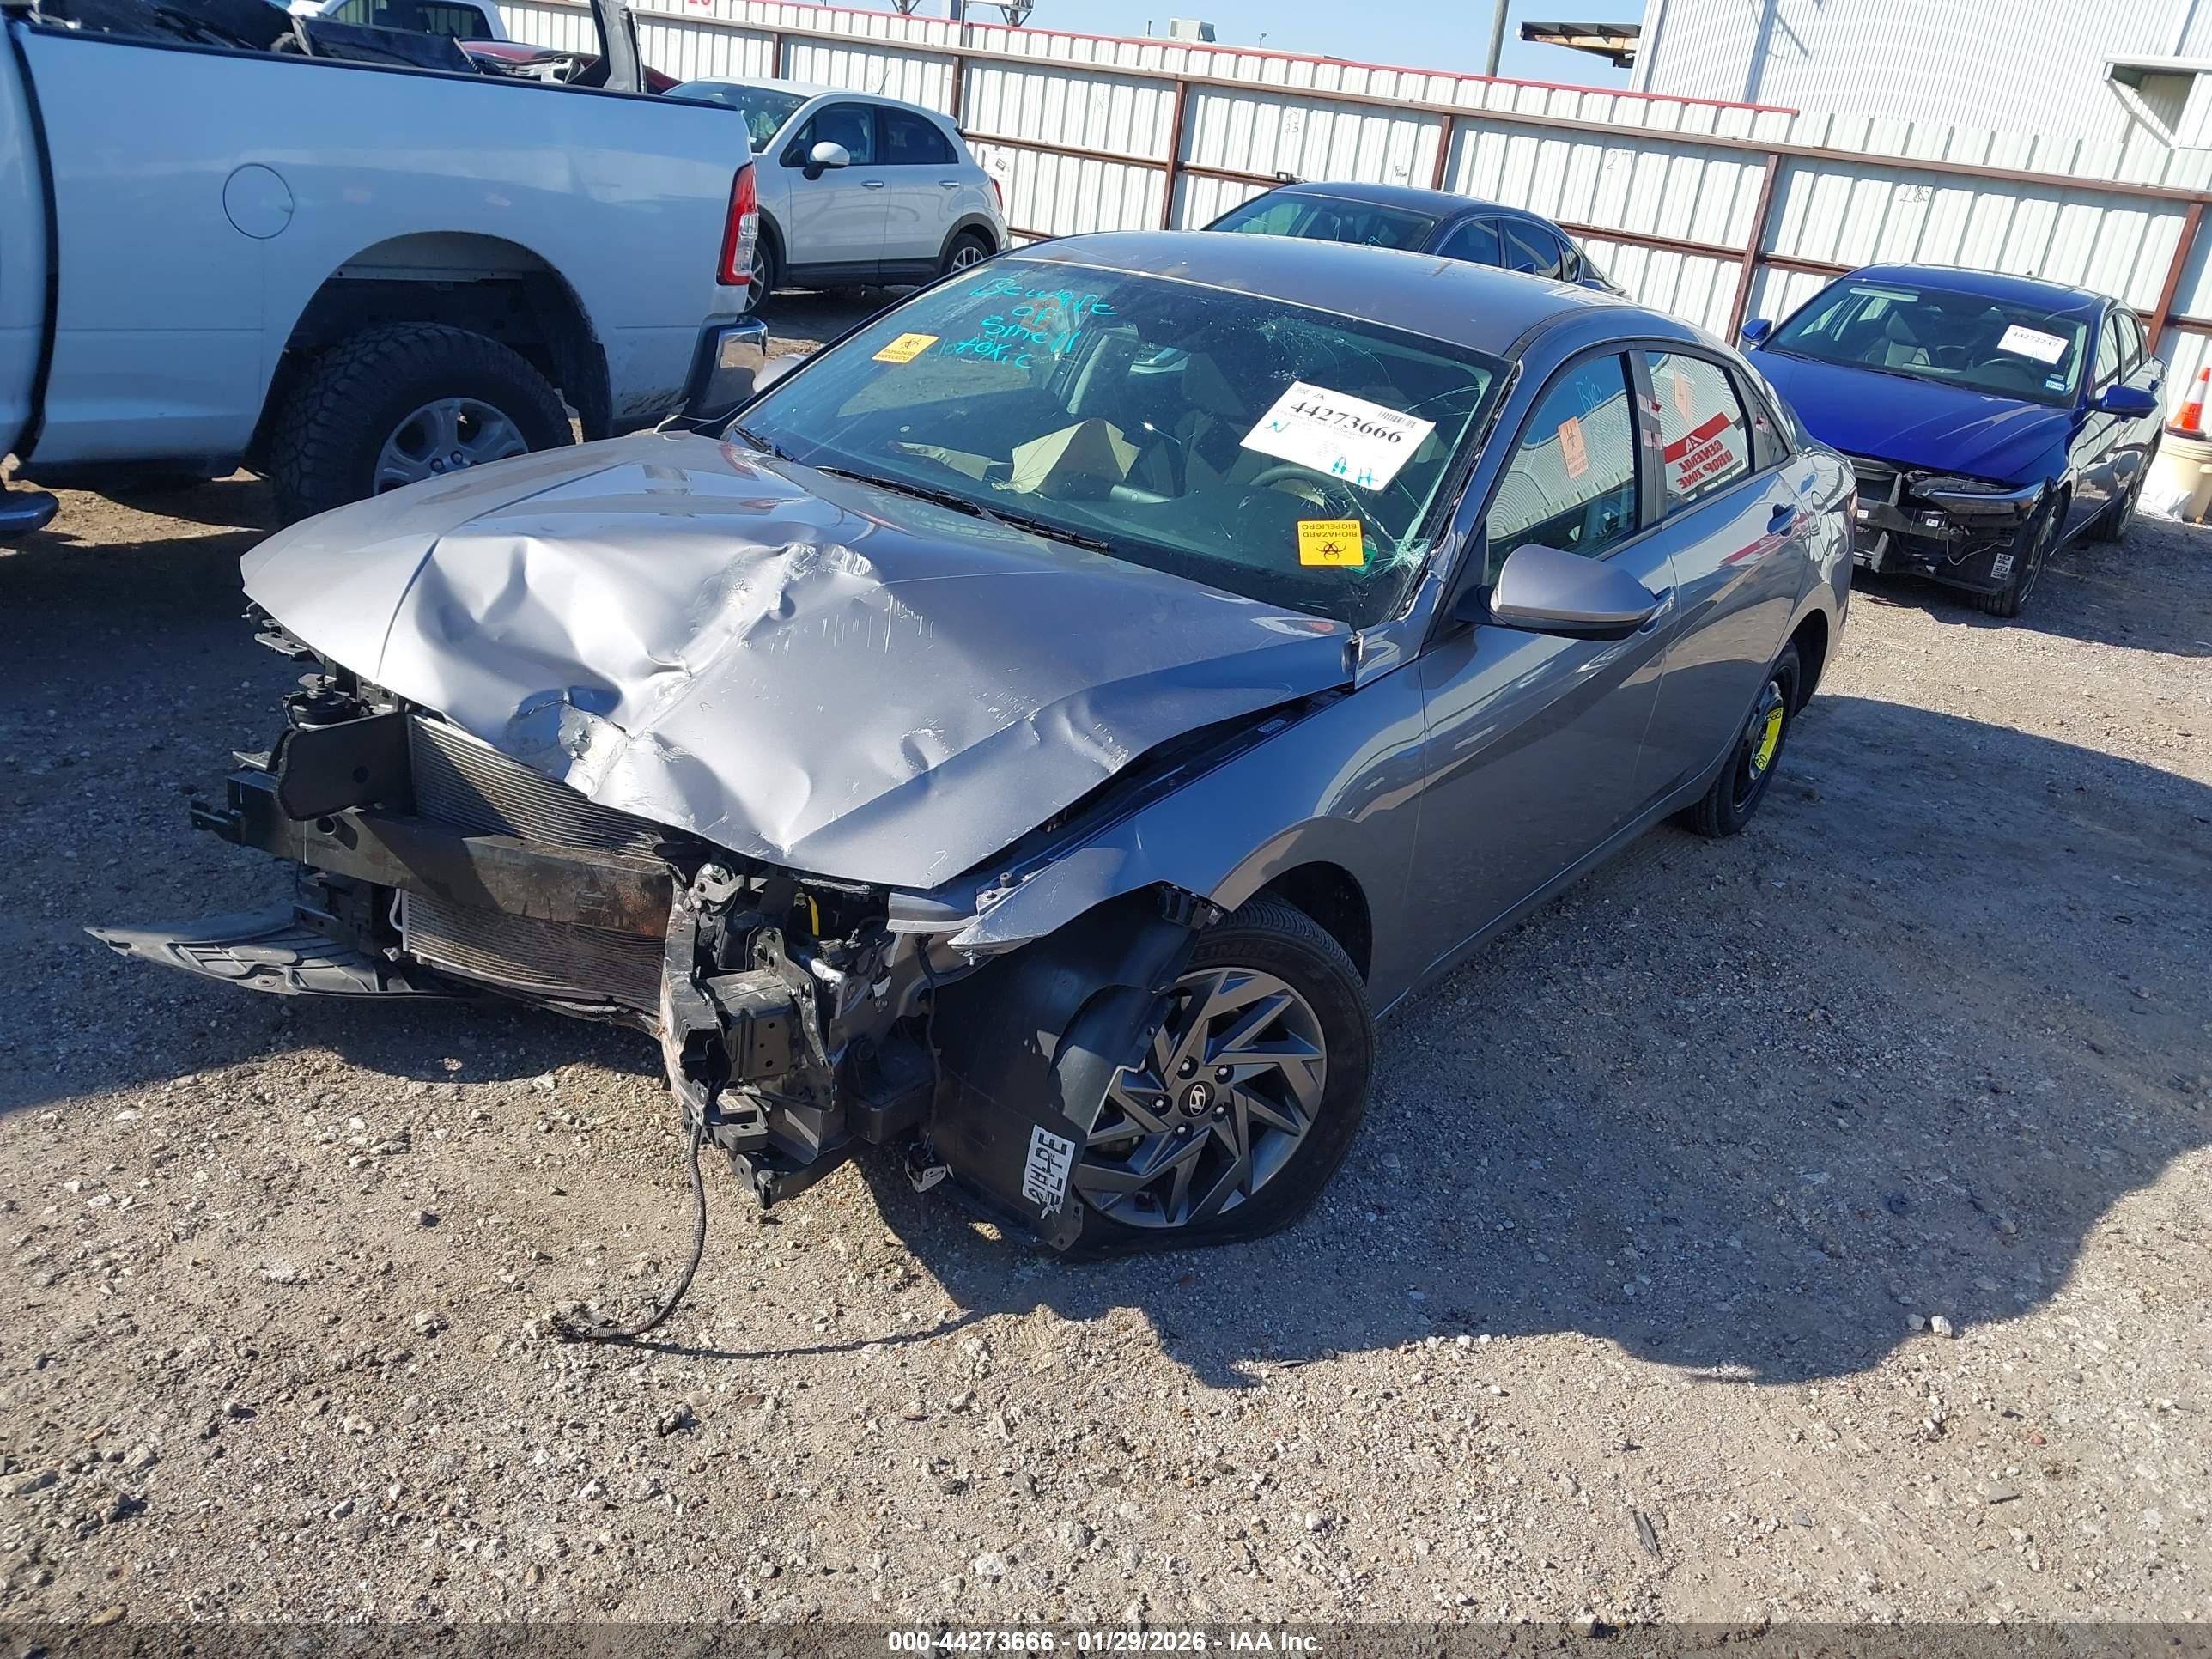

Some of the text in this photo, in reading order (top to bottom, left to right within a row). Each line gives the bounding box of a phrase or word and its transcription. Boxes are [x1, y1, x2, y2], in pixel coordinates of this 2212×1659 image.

[982, 317, 1081, 353] Smell
[1291, 402, 1406, 443] 44273666
[1757, 754, 1768, 769] 50
